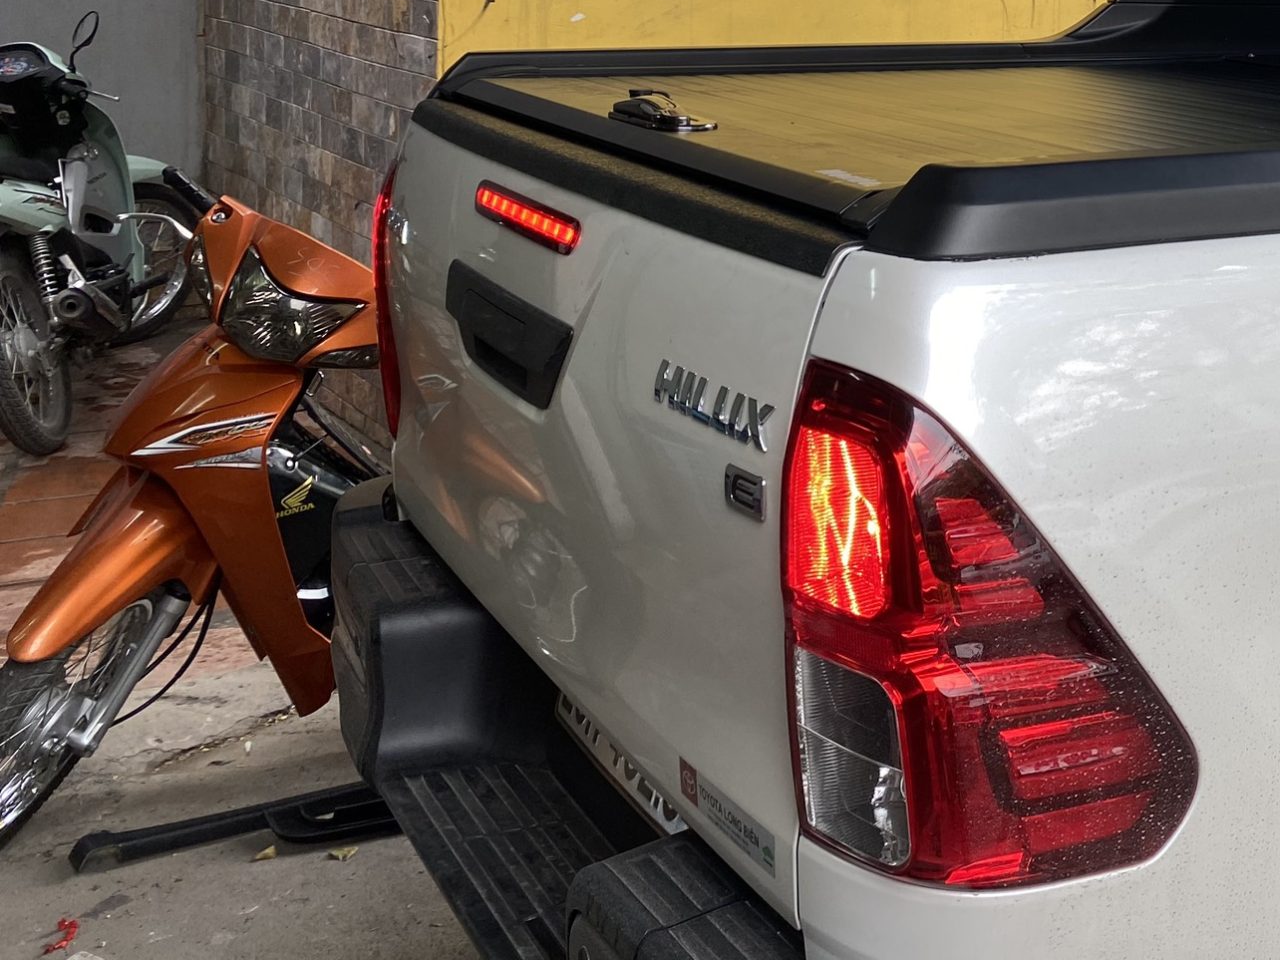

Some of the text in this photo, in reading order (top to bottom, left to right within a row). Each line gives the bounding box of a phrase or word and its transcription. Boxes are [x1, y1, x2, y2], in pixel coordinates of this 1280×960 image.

[654, 358, 776, 453] HILUX
[276, 502, 315, 518] HONDA
[698, 784, 722, 816] TOYOTA
